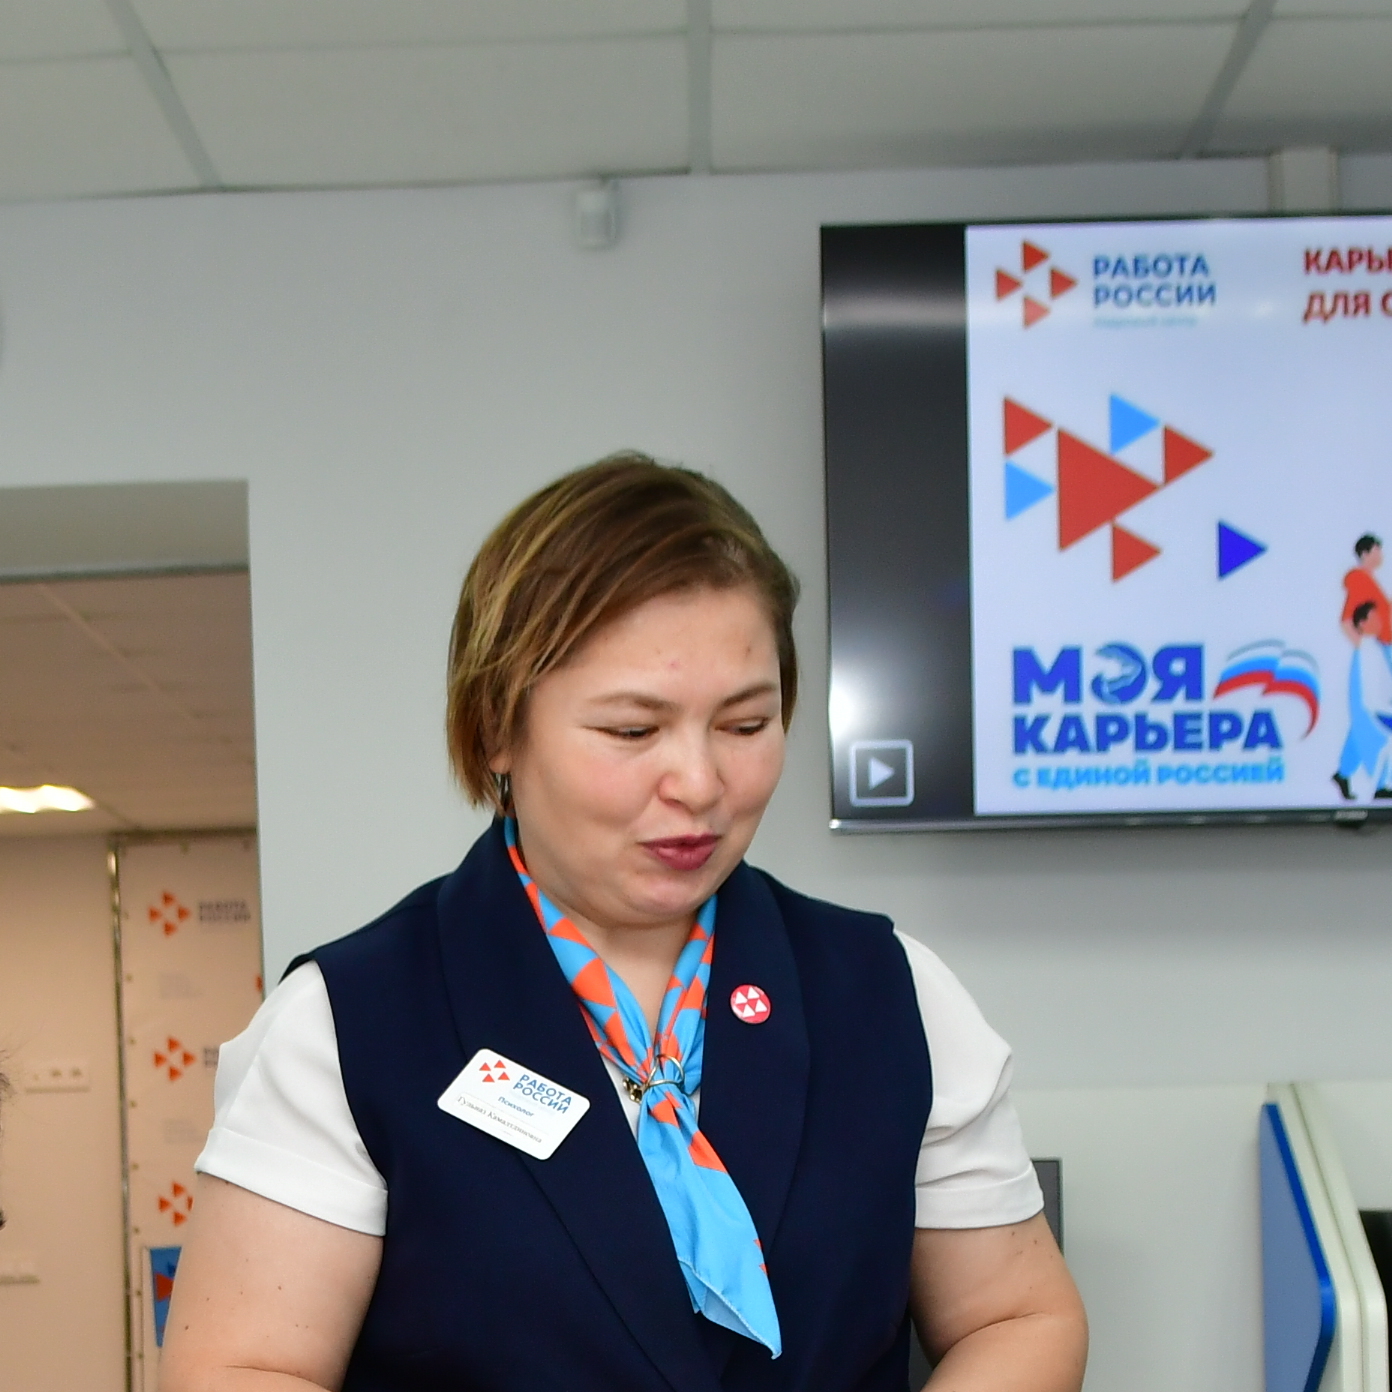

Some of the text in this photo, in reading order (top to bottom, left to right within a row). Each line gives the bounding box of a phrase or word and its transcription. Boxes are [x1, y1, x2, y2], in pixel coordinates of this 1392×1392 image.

[1094, 253, 1210, 278] РАБОТА
[1094, 282, 1216, 308] РОССИИ
[1302, 289, 1372, 324] ДЛЯ
[1013, 709, 1284, 754] КАРЬЕРА
[1012, 756, 1285, 791] С ЕДИНОЙ РОССИЕЙ
[513, 1082, 569, 1114] РОССИИ
[519, 1074, 573, 1106] РАБОТА
